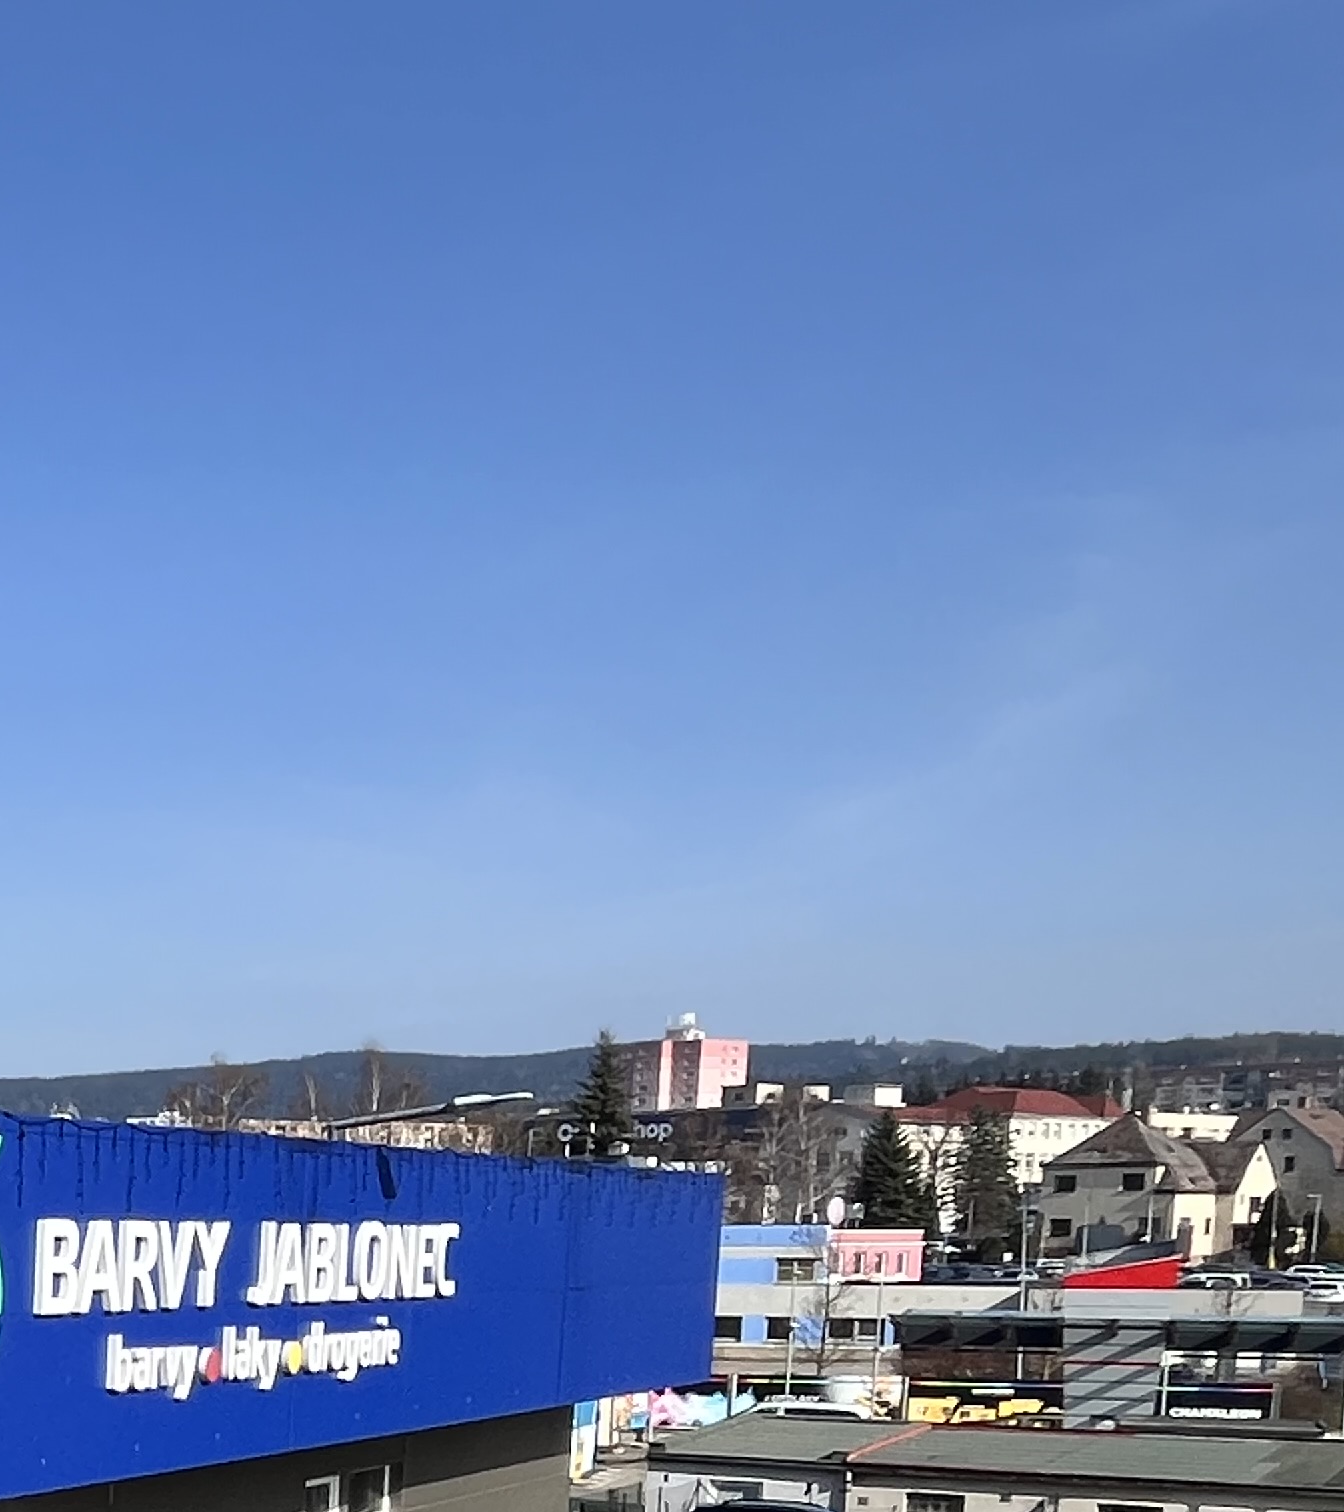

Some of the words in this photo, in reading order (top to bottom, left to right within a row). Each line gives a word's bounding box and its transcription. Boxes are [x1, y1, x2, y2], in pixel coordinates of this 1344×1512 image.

[33, 1219, 231, 1316] BARVY
[246, 1220, 460, 1306] JABLONEC
[105, 1333, 199, 1401] barvy
[221, 1325, 282, 1391] laky
[302, 1315, 402, 1382] drogerie
